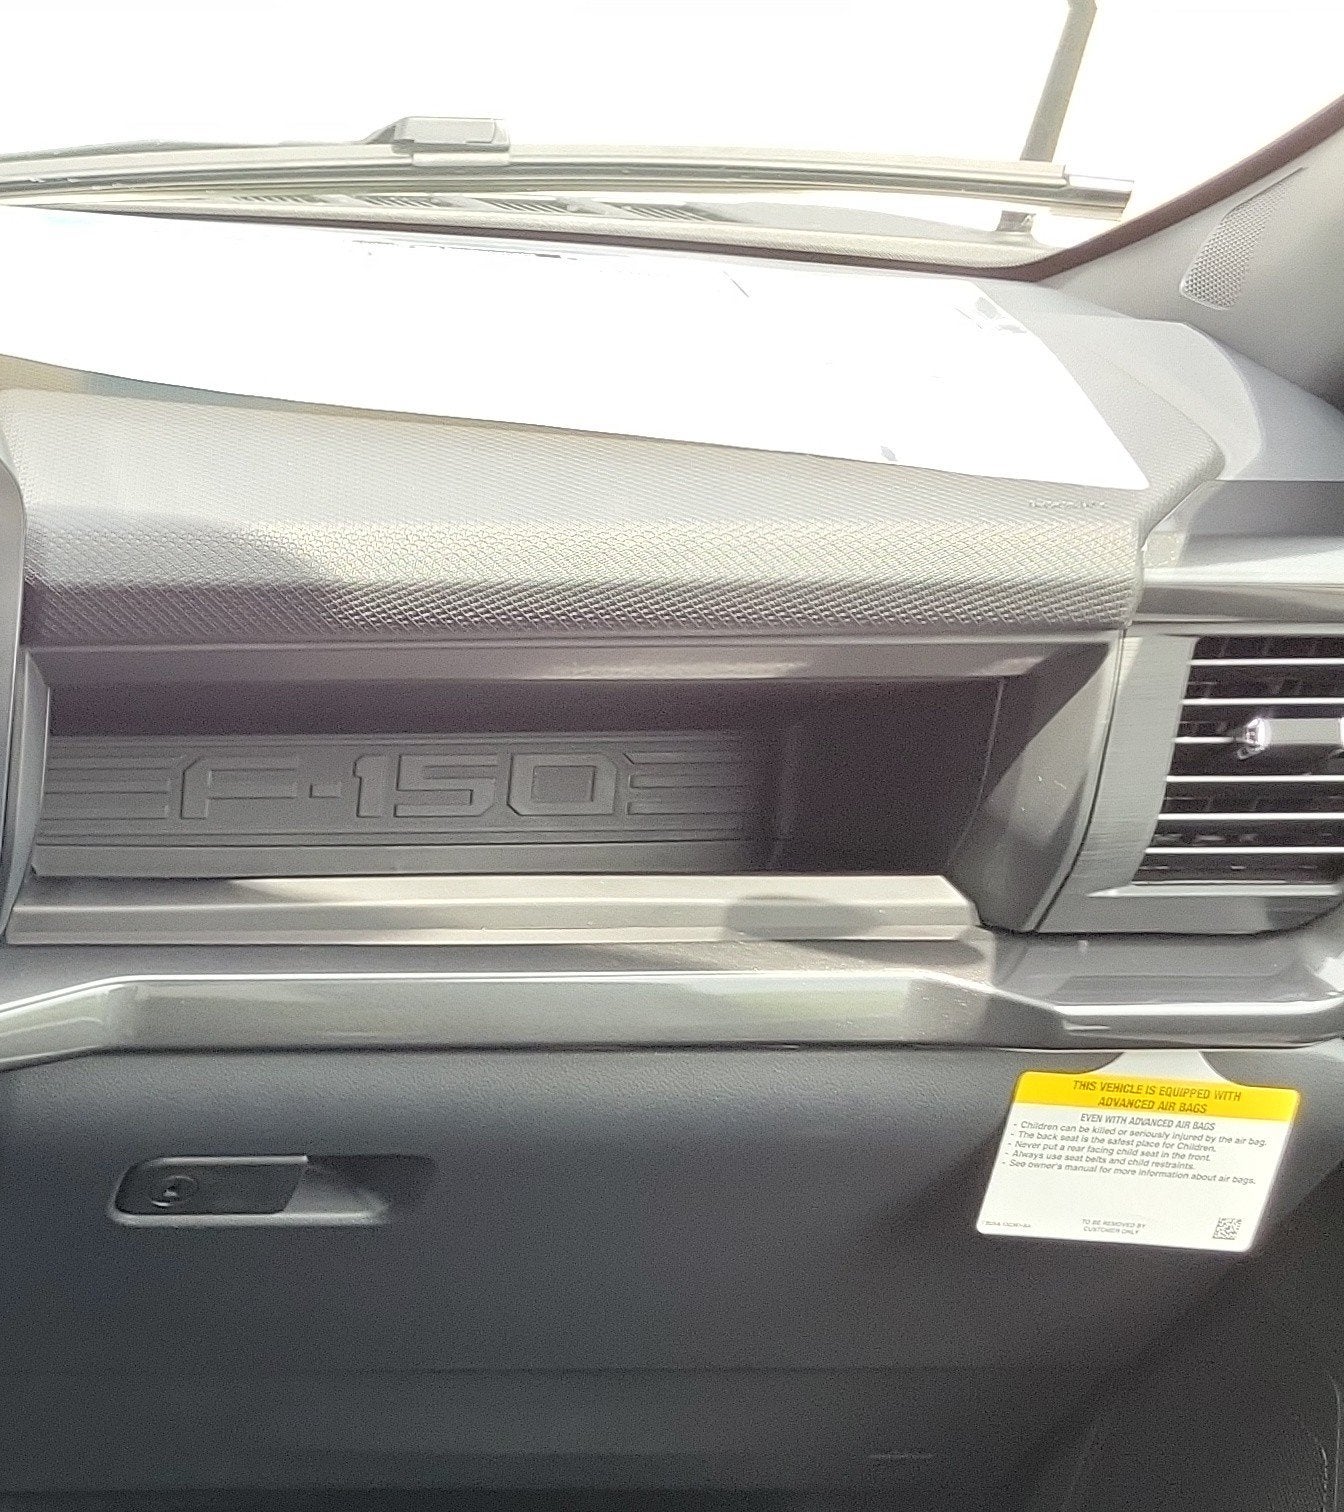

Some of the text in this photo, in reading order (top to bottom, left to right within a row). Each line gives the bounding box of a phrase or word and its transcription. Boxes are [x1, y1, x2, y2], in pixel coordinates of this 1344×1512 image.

[179, 752, 622, 822] F-150
[1073, 1080, 1242, 1101] THIS VEHICLE IS EQUIPPED WITH
[1097, 1096, 1208, 1114] ADVANCED AIR BAGS
[1020, 1120, 1058, 1131] Children
[1092, 1126, 1116, 1135] killed
[1129, 1130, 1171, 1140] seriously
[1172, 1131, 1204, 1142] injured
[1218, 1136, 1232, 1144] the
[1080, 1113, 1216, 1131] EVEN WITH ADVANCED AIR BAGS
[1018, 1130, 1035, 1139] The
[1037, 1132, 1057, 1141] back
[1060, 1134, 1079, 1142] seat
[1091, 1136, 1105, 1144] the
[1107, 1137, 1134, 1146] safest
[1135, 1139, 1160, 1149] place
[1012, 1149, 1044, 1159] Always
[1064, 1154, 1083, 1162] seat
[1085, 1155, 1107, 1164] belts
[1108, 1157, 1126, 1165] and
[1127, 1158, 1150, 1167] child
[1014, 1140, 1041, 1149] Never
[1042, 1143, 1058, 1151] put
[1087, 1145, 1115, 1156] facing
[1116, 1148, 1138, 1156] child
[1140, 1149, 1159, 1158] seat
[1172, 1152, 1186, 1160] the
[1009, 1159, 1026, 1168] See
[1027, 1161, 1063, 1170] owner's
[1064, 1163, 1097, 1173] manual
[1113, 1168, 1137, 1176] more
[1138, 1169, 1189, 1180] information
[1191, 1173, 1217, 1182] about
